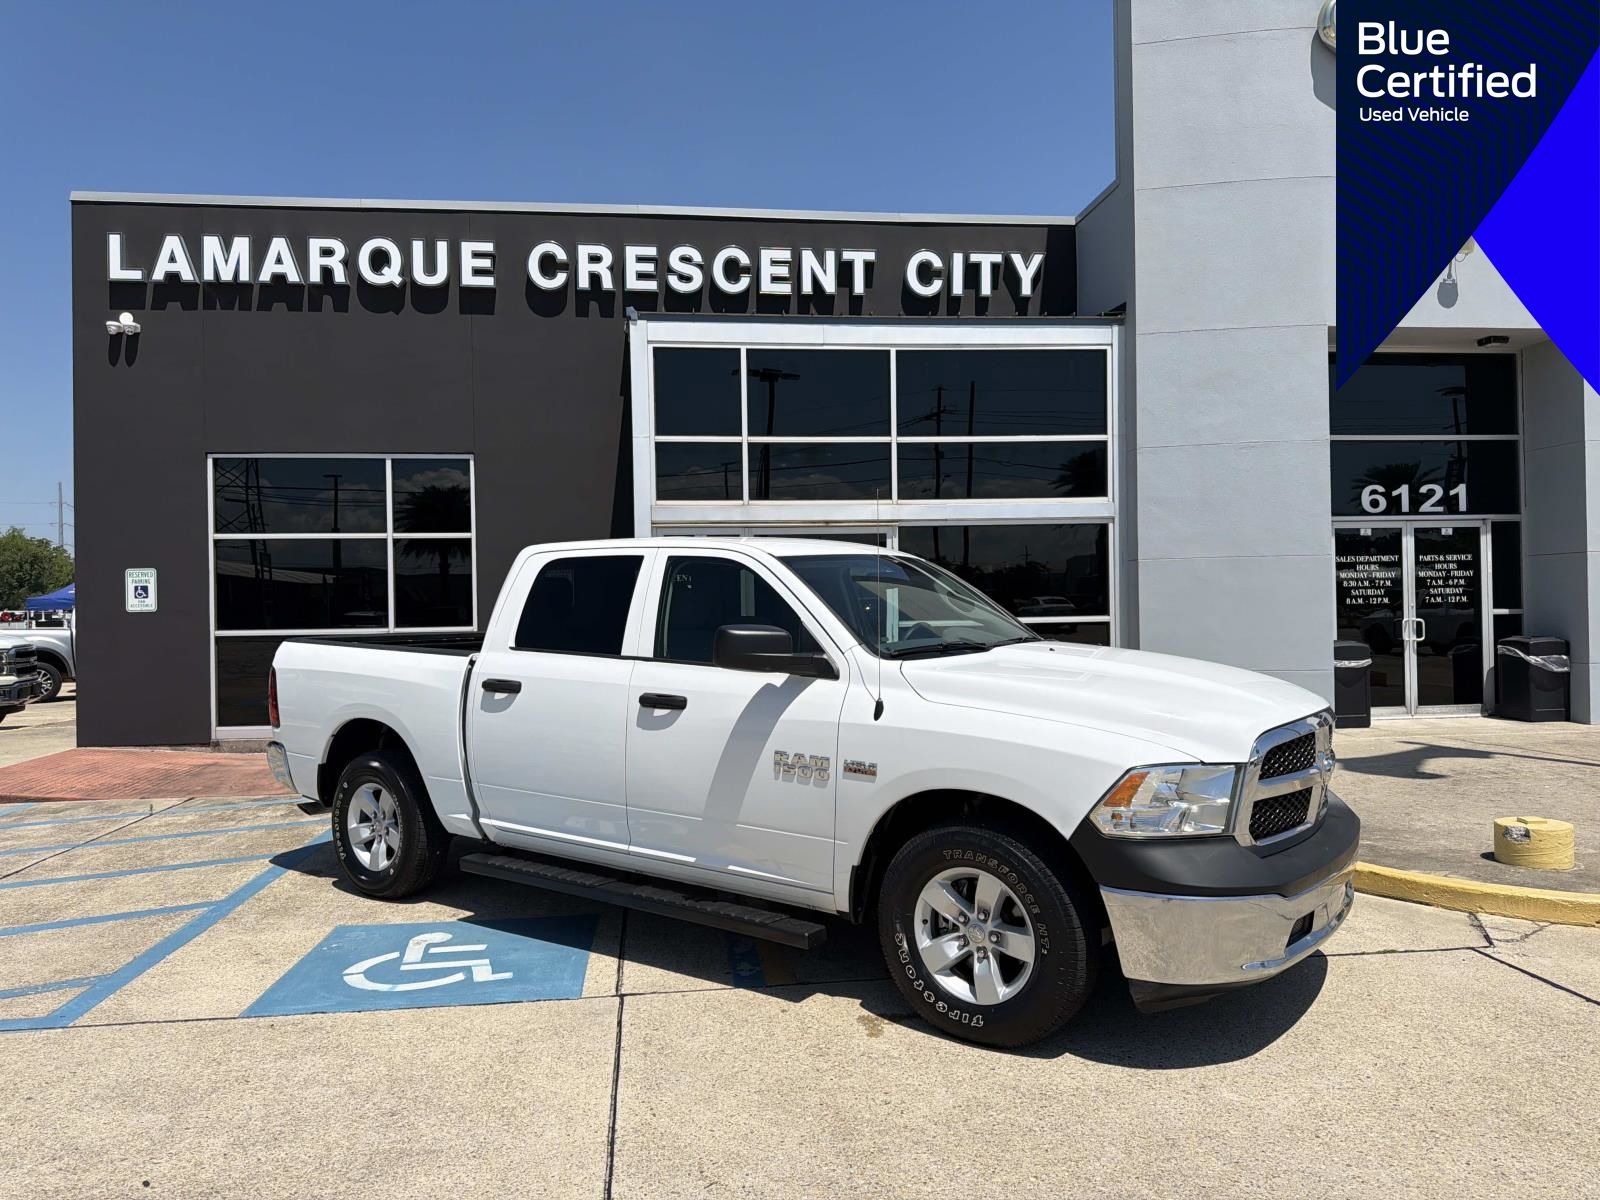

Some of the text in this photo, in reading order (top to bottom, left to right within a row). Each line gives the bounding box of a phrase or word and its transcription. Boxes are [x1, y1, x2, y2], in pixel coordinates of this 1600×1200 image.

[106, 231, 1047, 298] LAMARQUE CRESCENT CITY
[1360, 483, 1467, 513] 6121
[774, 750, 830, 768] RAM
[774, 762, 830, 781] 1500
